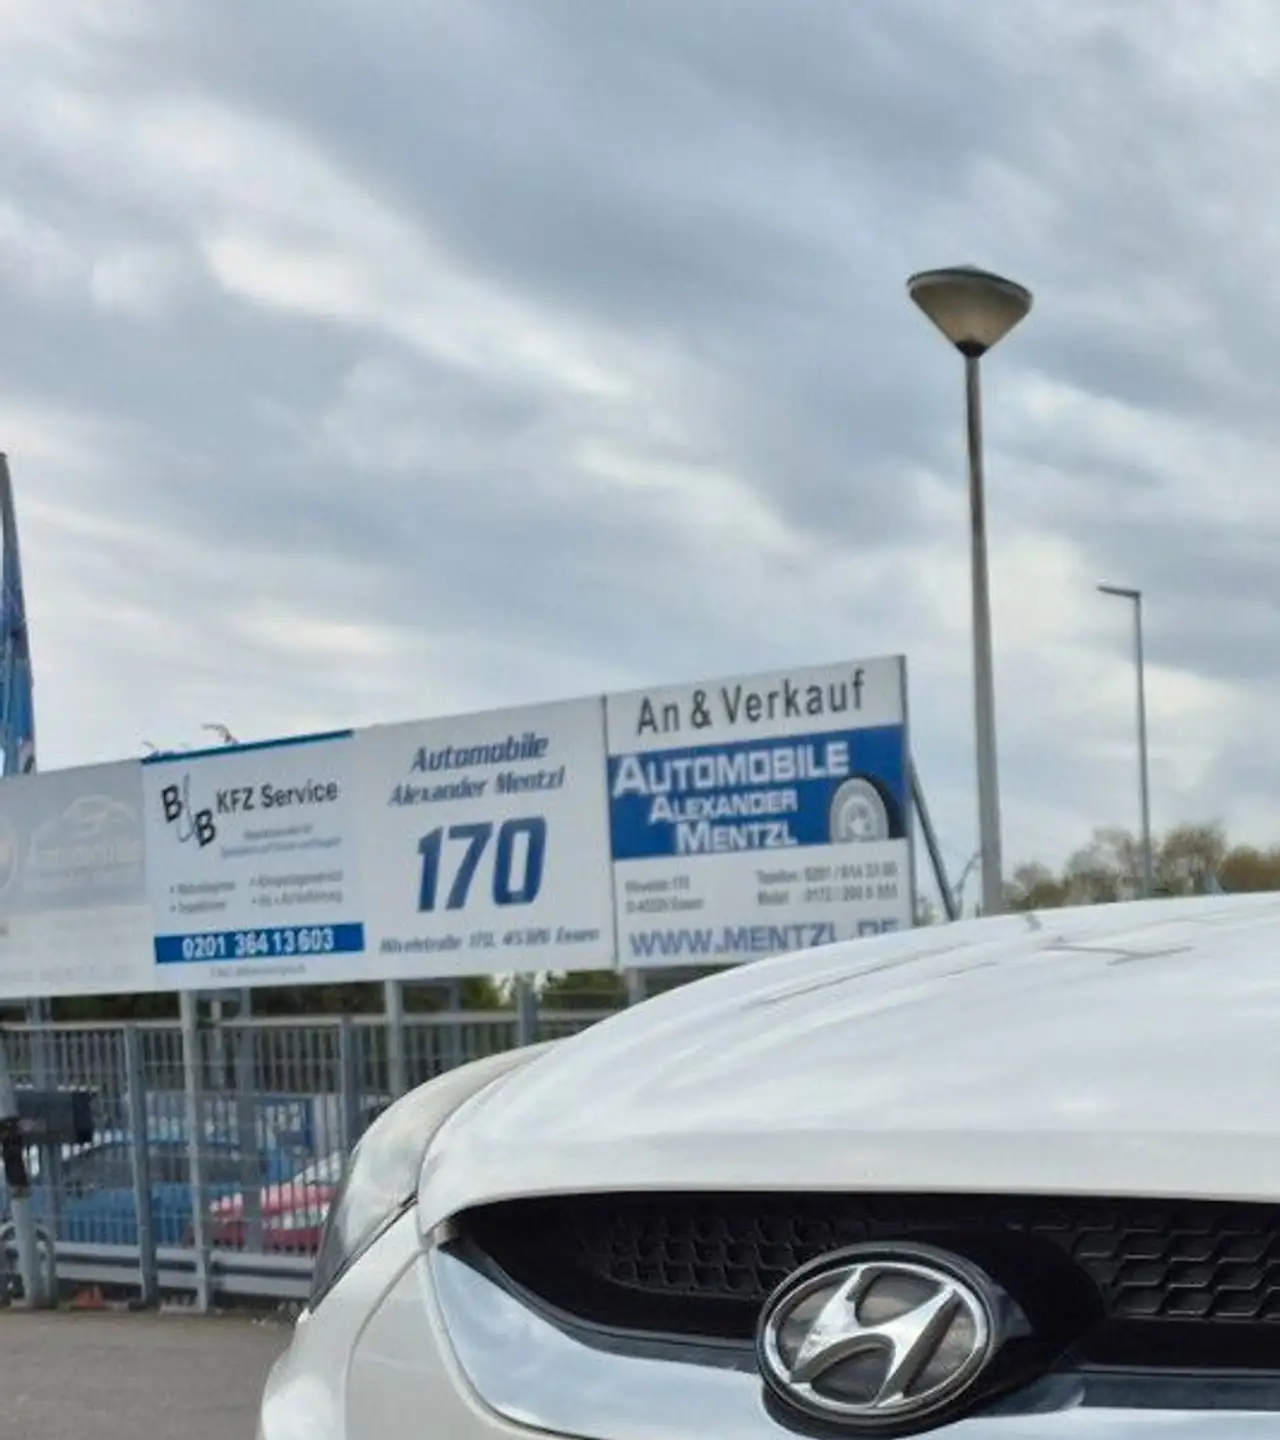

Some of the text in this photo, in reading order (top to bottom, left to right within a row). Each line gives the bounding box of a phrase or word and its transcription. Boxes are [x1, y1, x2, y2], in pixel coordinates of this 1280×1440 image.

[636, 667, 866, 736] An & Verkauf
[409, 731, 549, 773] Automobile
[612, 740, 849, 798] AUTOMOBILE
[216, 777, 339, 814] KFZ Service
[387, 764, 566, 806] Alexander Mentzl
[649, 788, 798, 825] ALEXANDER
[675, 819, 799, 856] MENTZL
[417, 816, 547, 913] 170
[182, 935, 226, 961] 0201
[272, 929, 295, 953] 13
[297, 926, 335, 952] 603
